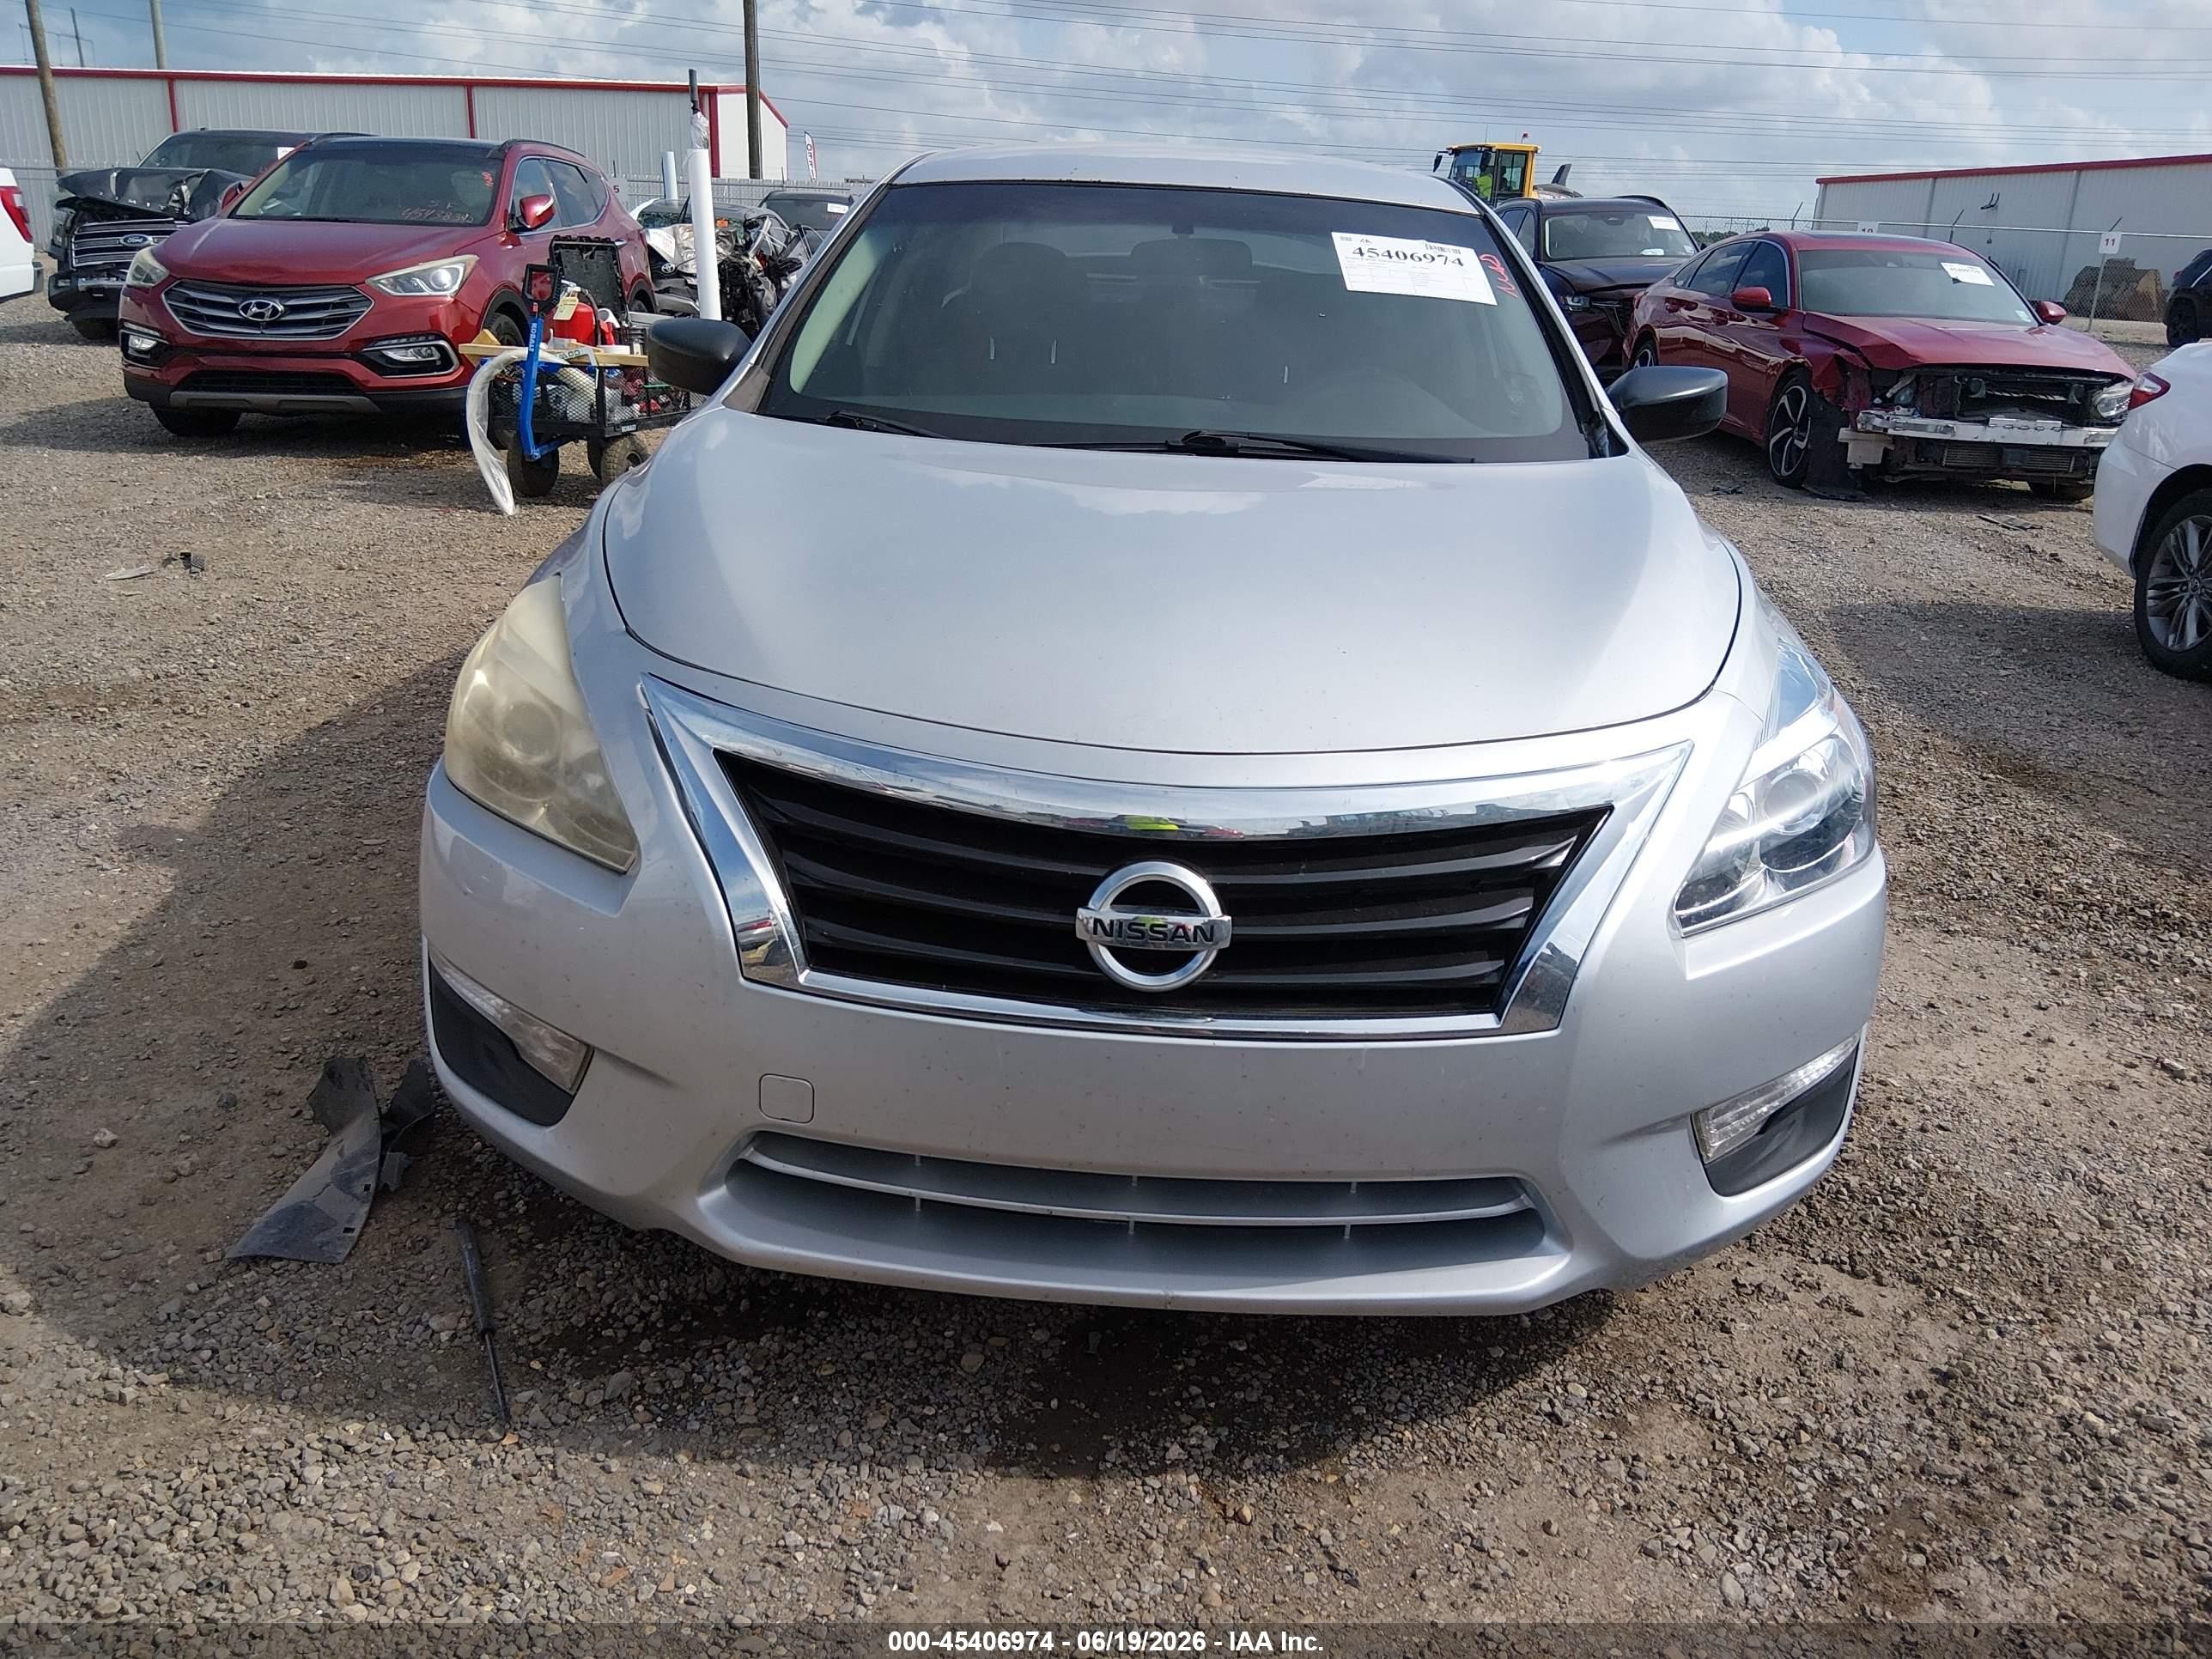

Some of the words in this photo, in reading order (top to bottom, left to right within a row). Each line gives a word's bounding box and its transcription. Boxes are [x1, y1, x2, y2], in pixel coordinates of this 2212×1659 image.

[613, 185, 620, 193] 5
[2104, 238, 2116, 246] 11
[1352, 246, 1464, 267] 45406974
[529, 322, 538, 353] KOBALT
[1092, 917, 1215, 943] NISSAN
